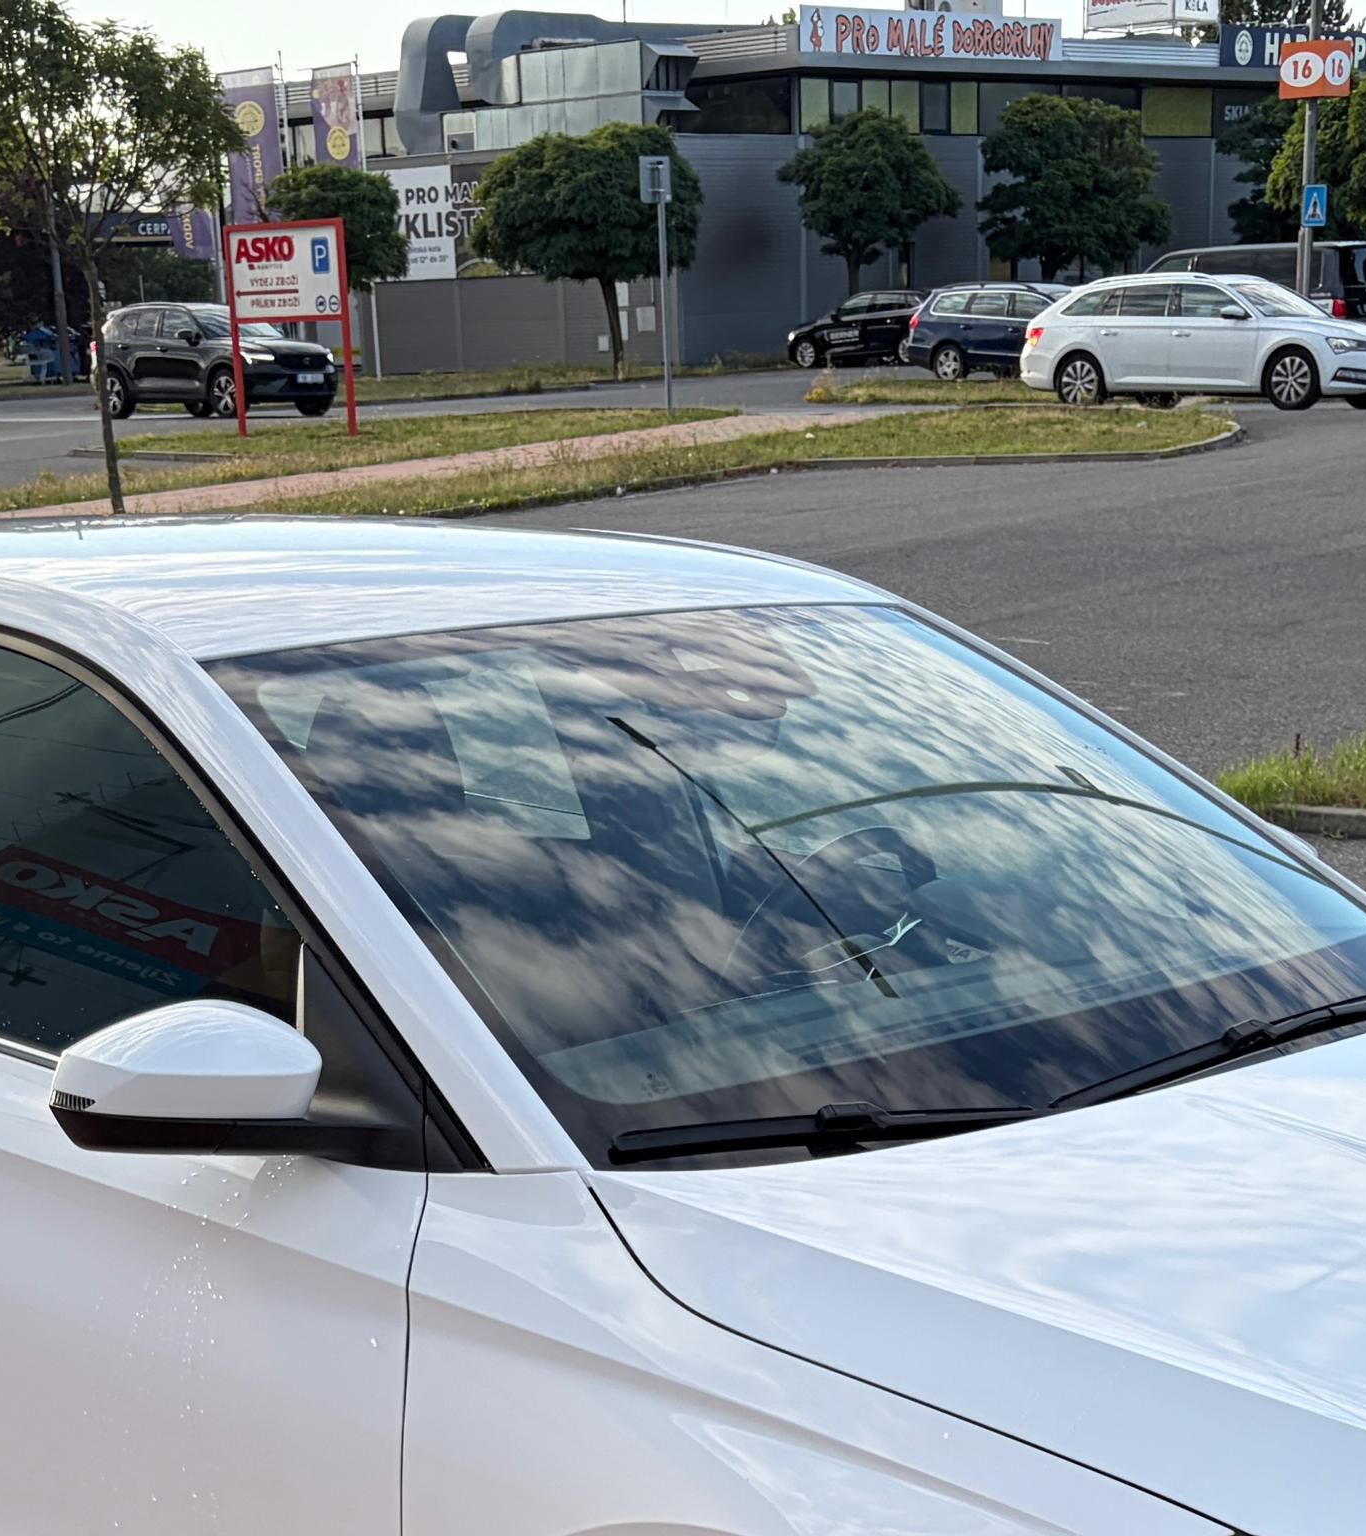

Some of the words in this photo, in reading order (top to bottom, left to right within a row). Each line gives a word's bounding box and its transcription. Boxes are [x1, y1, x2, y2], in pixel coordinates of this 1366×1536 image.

[835, 14, 880, 53] PRO
[887, 14, 945, 56] MALÉ
[952, 19, 1054, 61] DOBRODRUHY
[1291, 59, 1313, 80] 16
[1331, 58, 1345, 78] 16
[404, 186, 439, 205] PRO
[235, 235, 295, 264] ASKO
[315, 245, 327, 267] P
